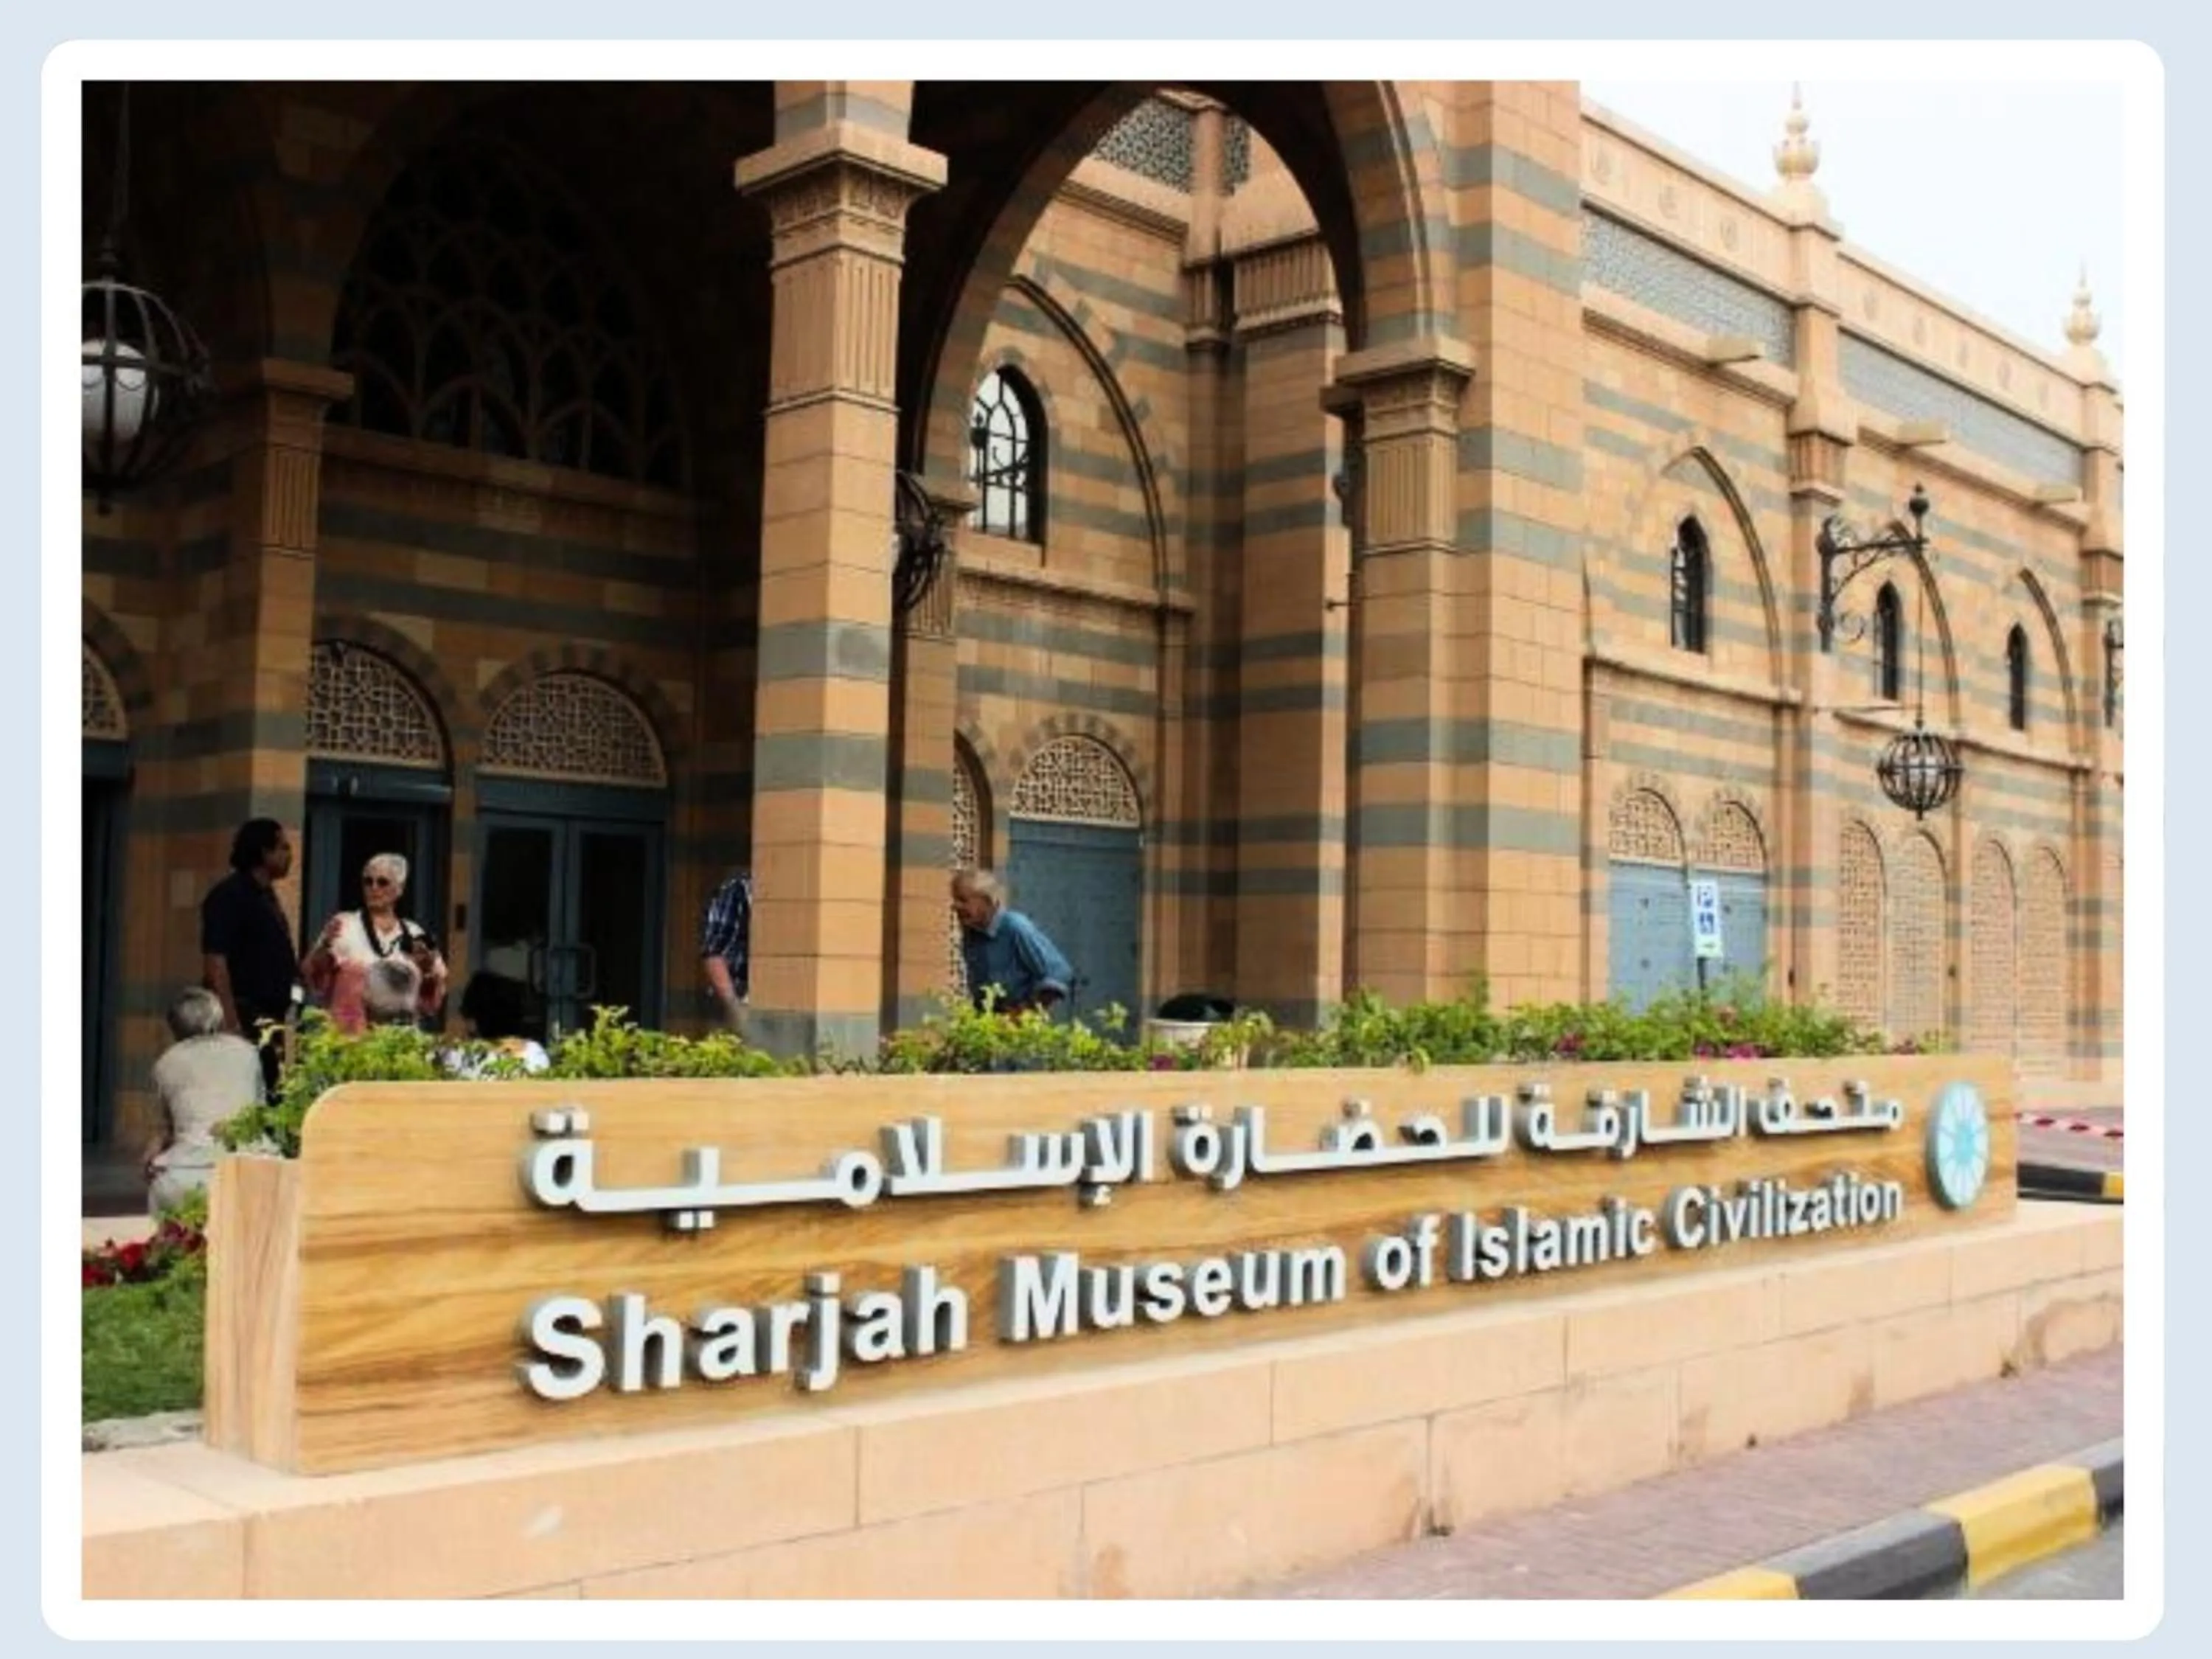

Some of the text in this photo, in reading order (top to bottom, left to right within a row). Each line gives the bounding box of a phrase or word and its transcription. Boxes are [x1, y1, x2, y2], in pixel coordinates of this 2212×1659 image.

[526, 1076, 1903, 1230] متحف الشارقة للحضارة الإسلامية
[519, 1172, 1903, 1399] Sharjah Museum of Islamic Civilization
